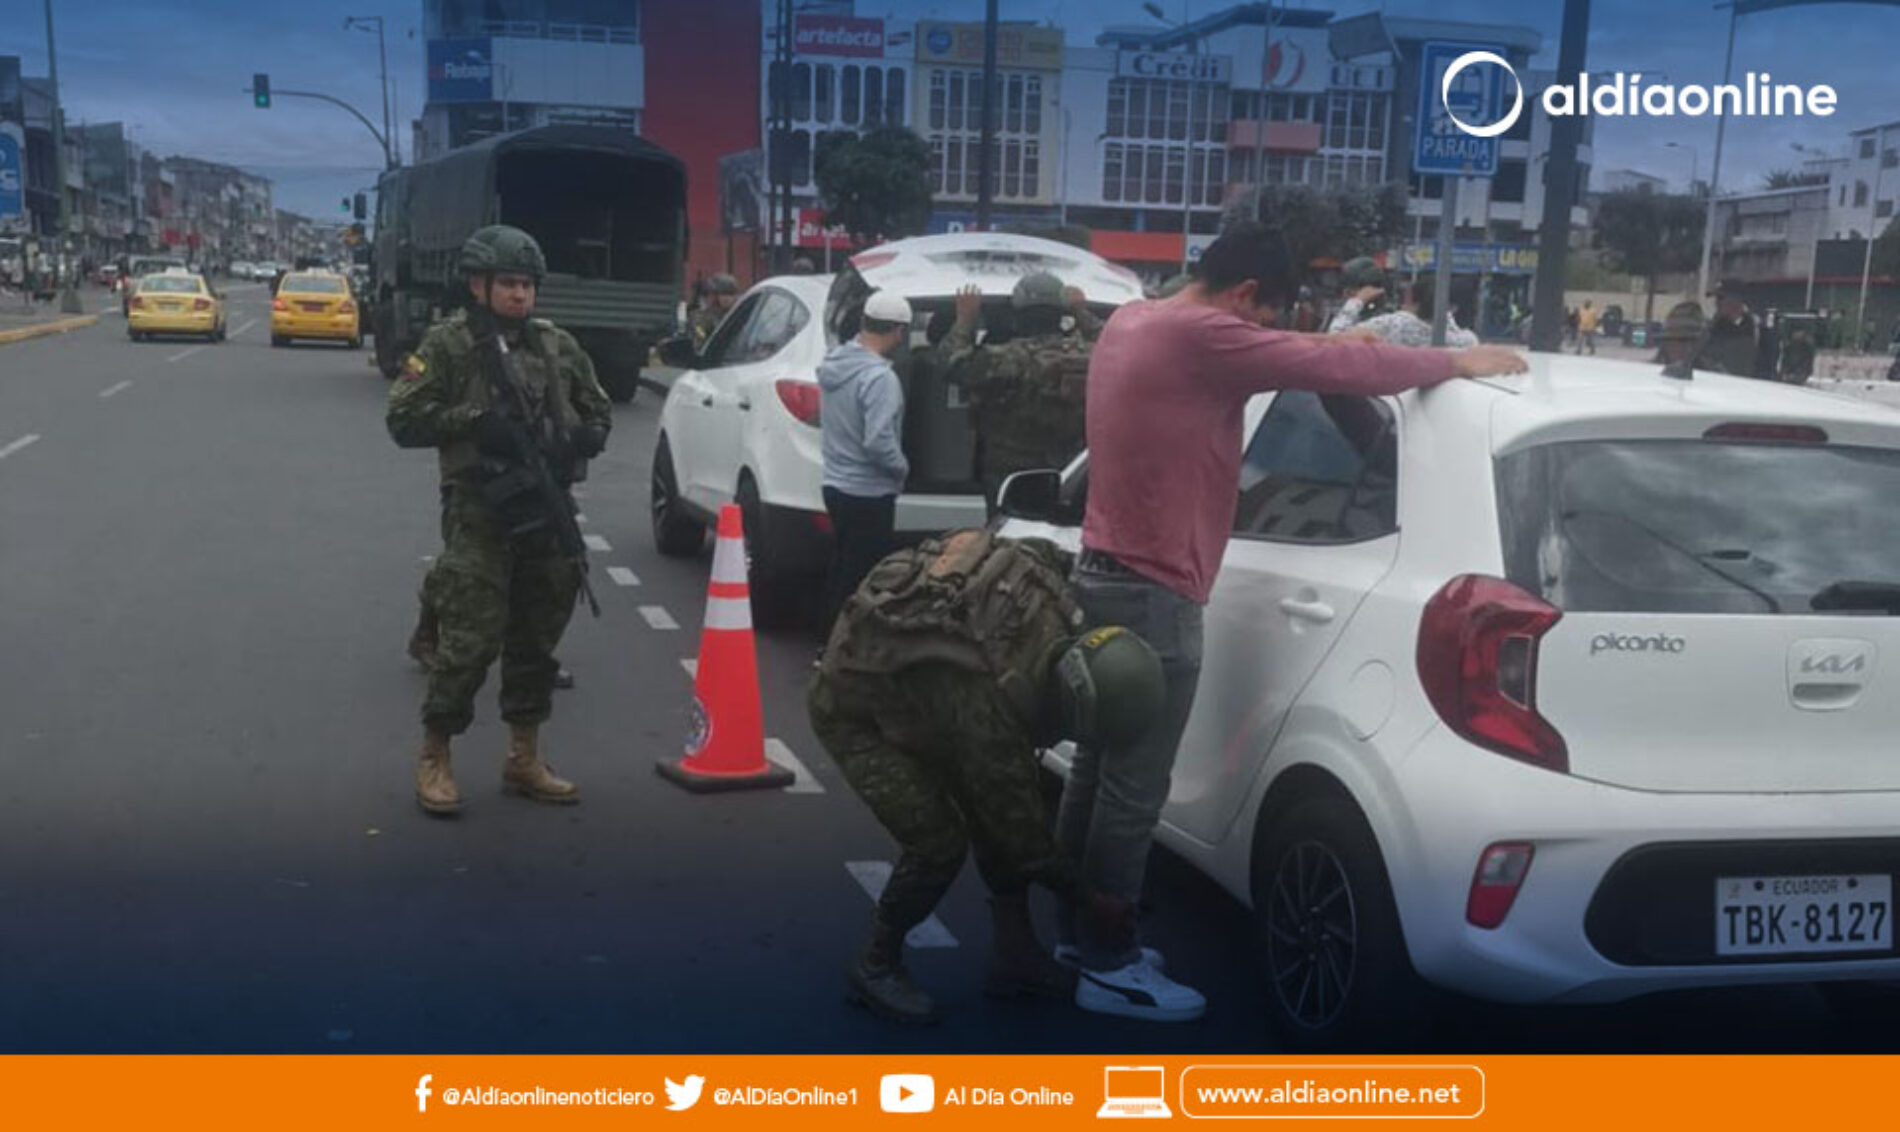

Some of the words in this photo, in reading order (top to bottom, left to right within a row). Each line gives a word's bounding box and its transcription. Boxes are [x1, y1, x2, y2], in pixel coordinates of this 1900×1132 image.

[796, 26, 881, 47] artefacta
[1422, 137, 1489, 160] PARADA
[1590, 633, 1686, 656] picanto
[1772, 878, 1839, 896] ECUADOR
[1723, 901, 1887, 946] TBK-8127
